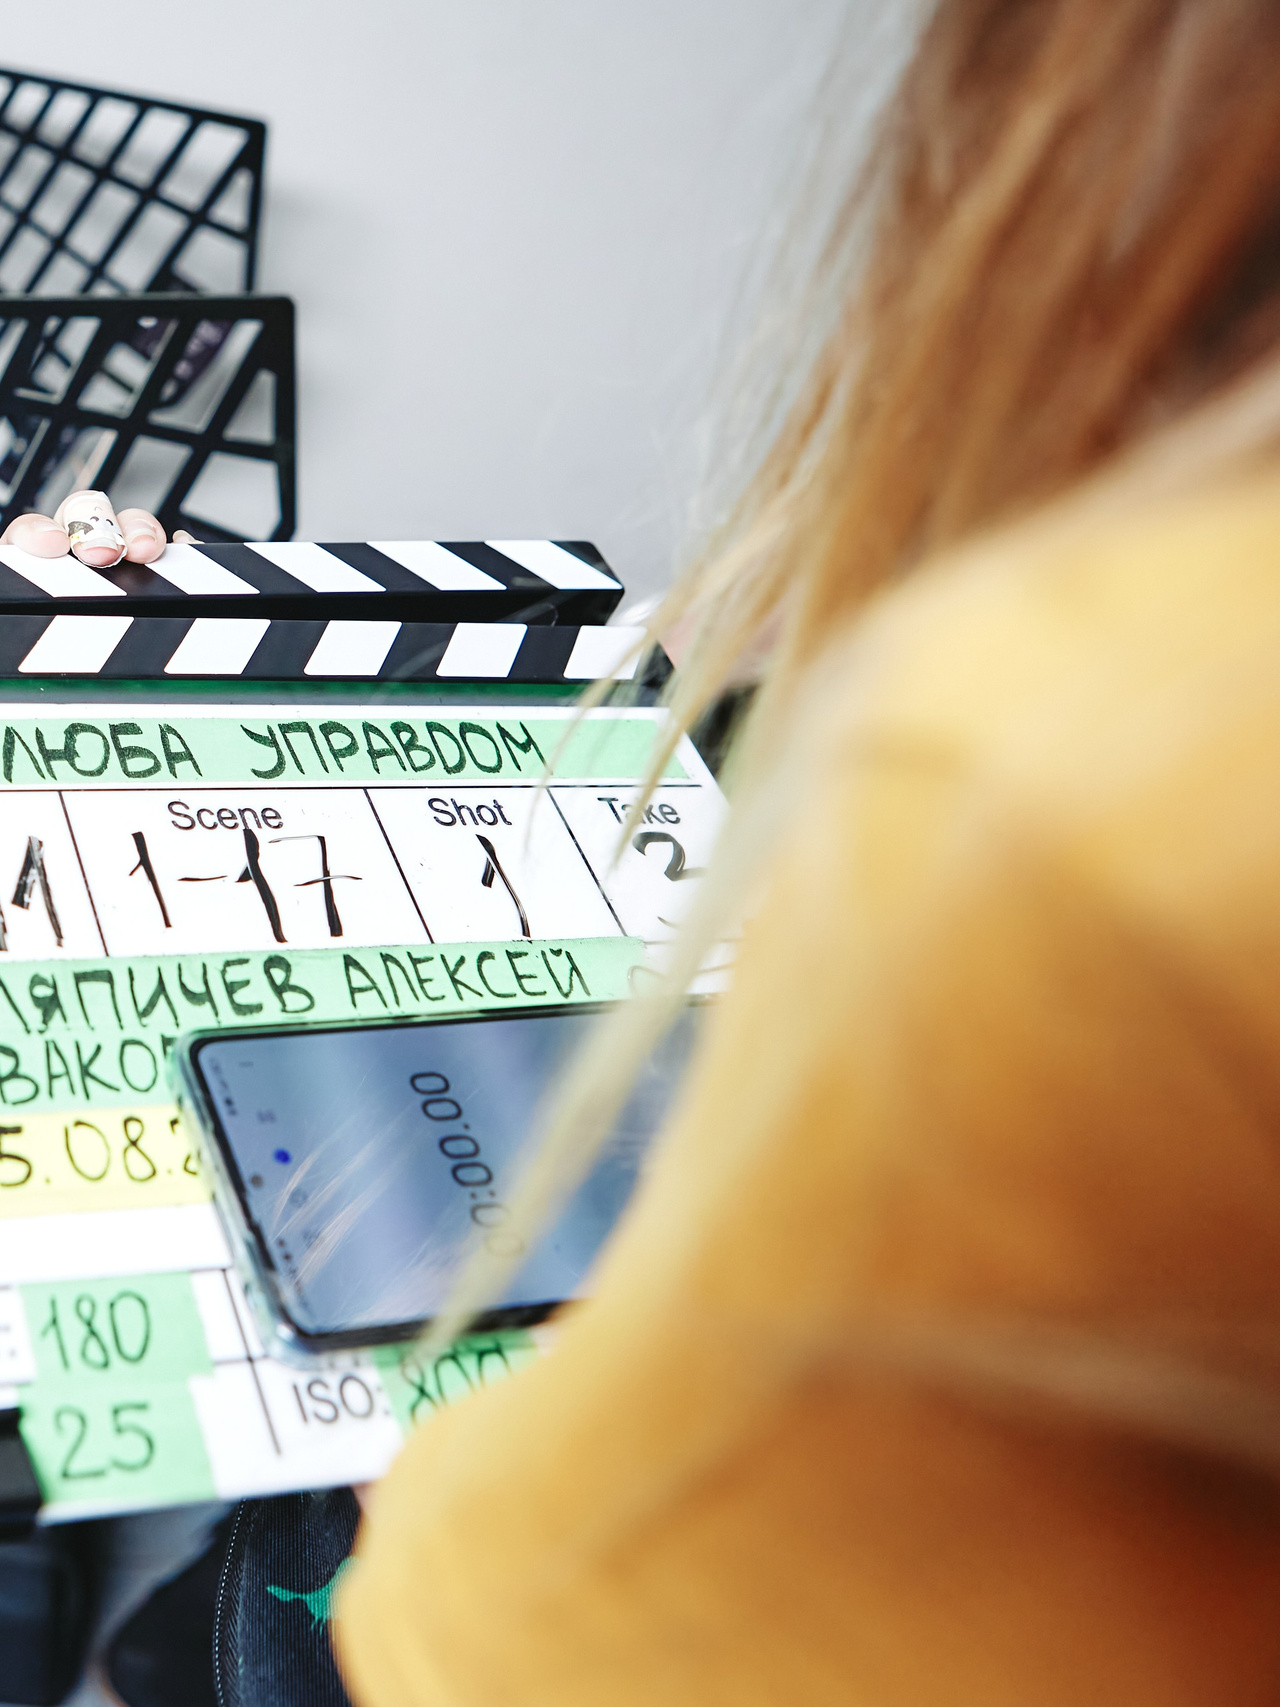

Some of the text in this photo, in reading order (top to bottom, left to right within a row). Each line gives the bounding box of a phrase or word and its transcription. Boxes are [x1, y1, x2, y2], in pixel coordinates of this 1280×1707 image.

[1, 722, 203, 783] ЛЮБА
[167, 800, 284, 831] Scene
[428, 797, 513, 827] Shot
[128, 829, 362, 944] 1-17
[475, 832, 532, 939] 1
[343, 946, 592, 1008] АЛЕКСЕЙ
[41, 1290, 152, 1372] 180
[292, 1374, 390, 1424] ISO:
[54, 1402, 157, 1481] 25
